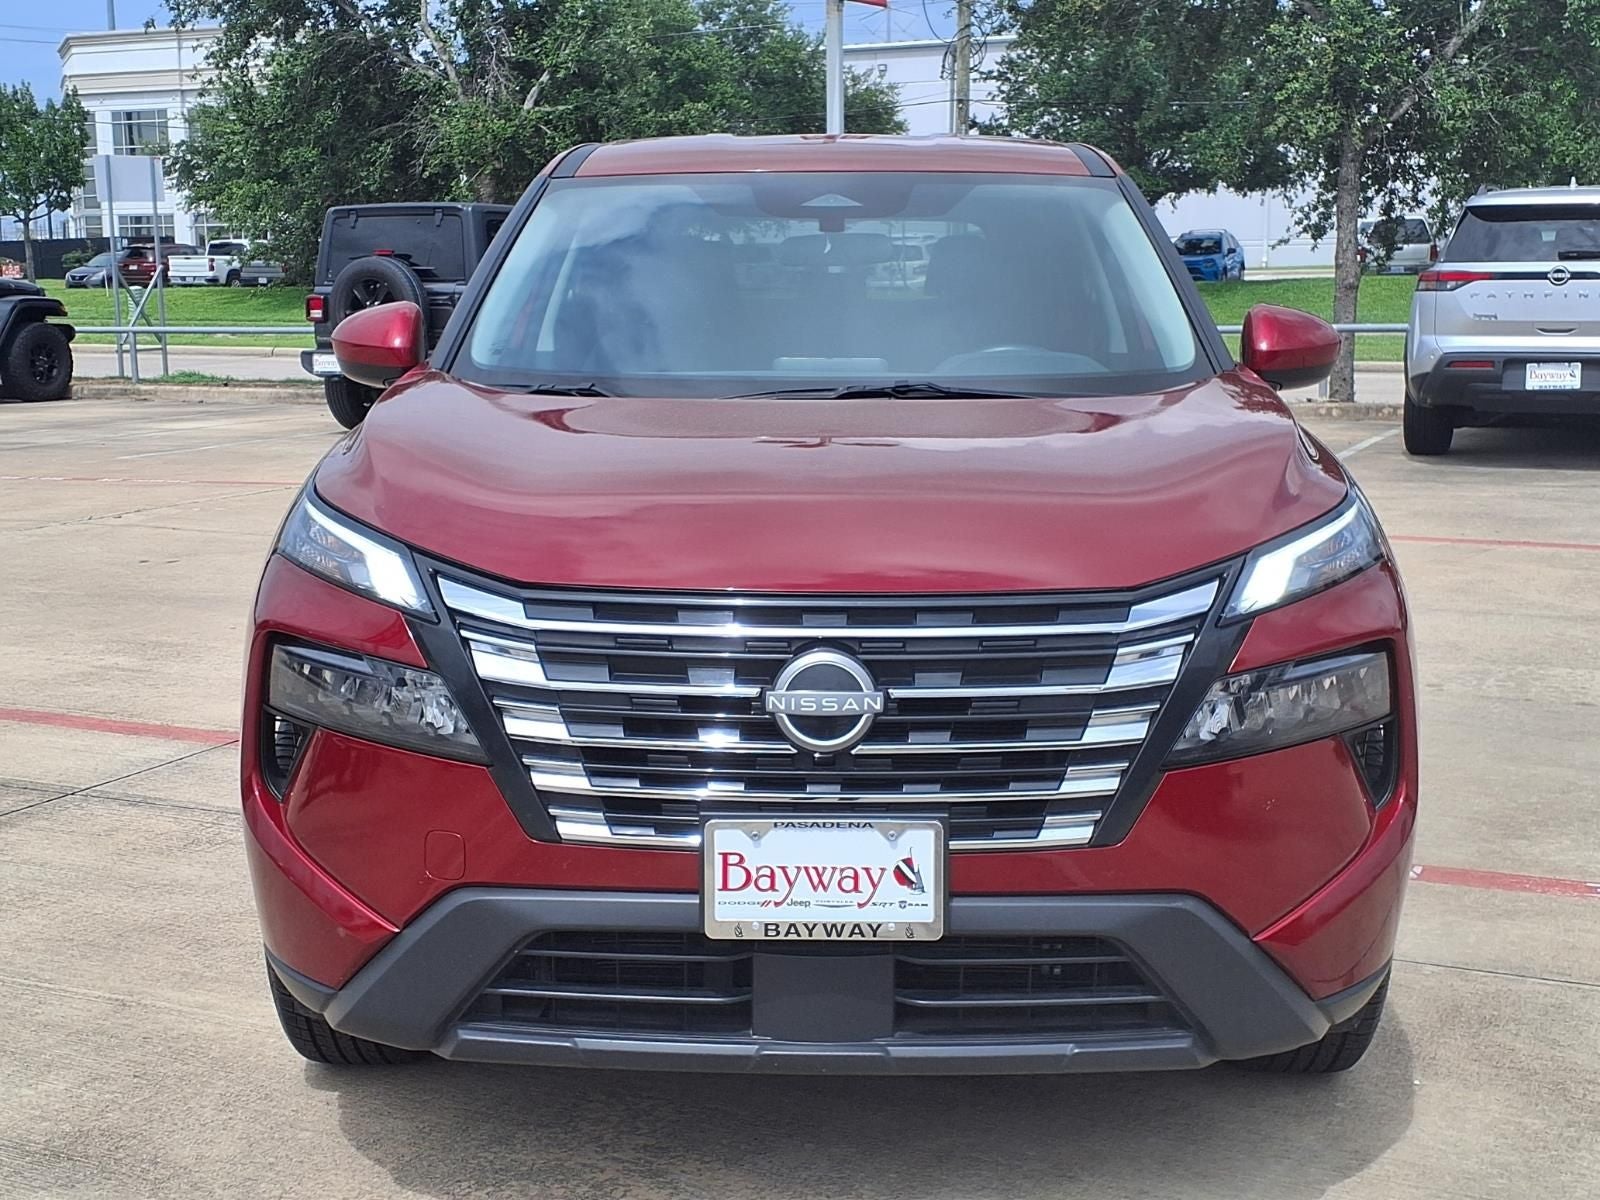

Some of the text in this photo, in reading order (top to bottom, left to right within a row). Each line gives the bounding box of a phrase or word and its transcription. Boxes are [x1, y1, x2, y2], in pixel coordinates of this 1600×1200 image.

[1470, 290, 1600, 299] PATHFIN
[768, 696, 881, 711] NISSAN
[773, 821, 874, 829] PASADENA
[717, 852, 887, 909] Bayway
[786, 898, 811, 909] Jeep
[763, 922, 882, 938] BAYWAY
